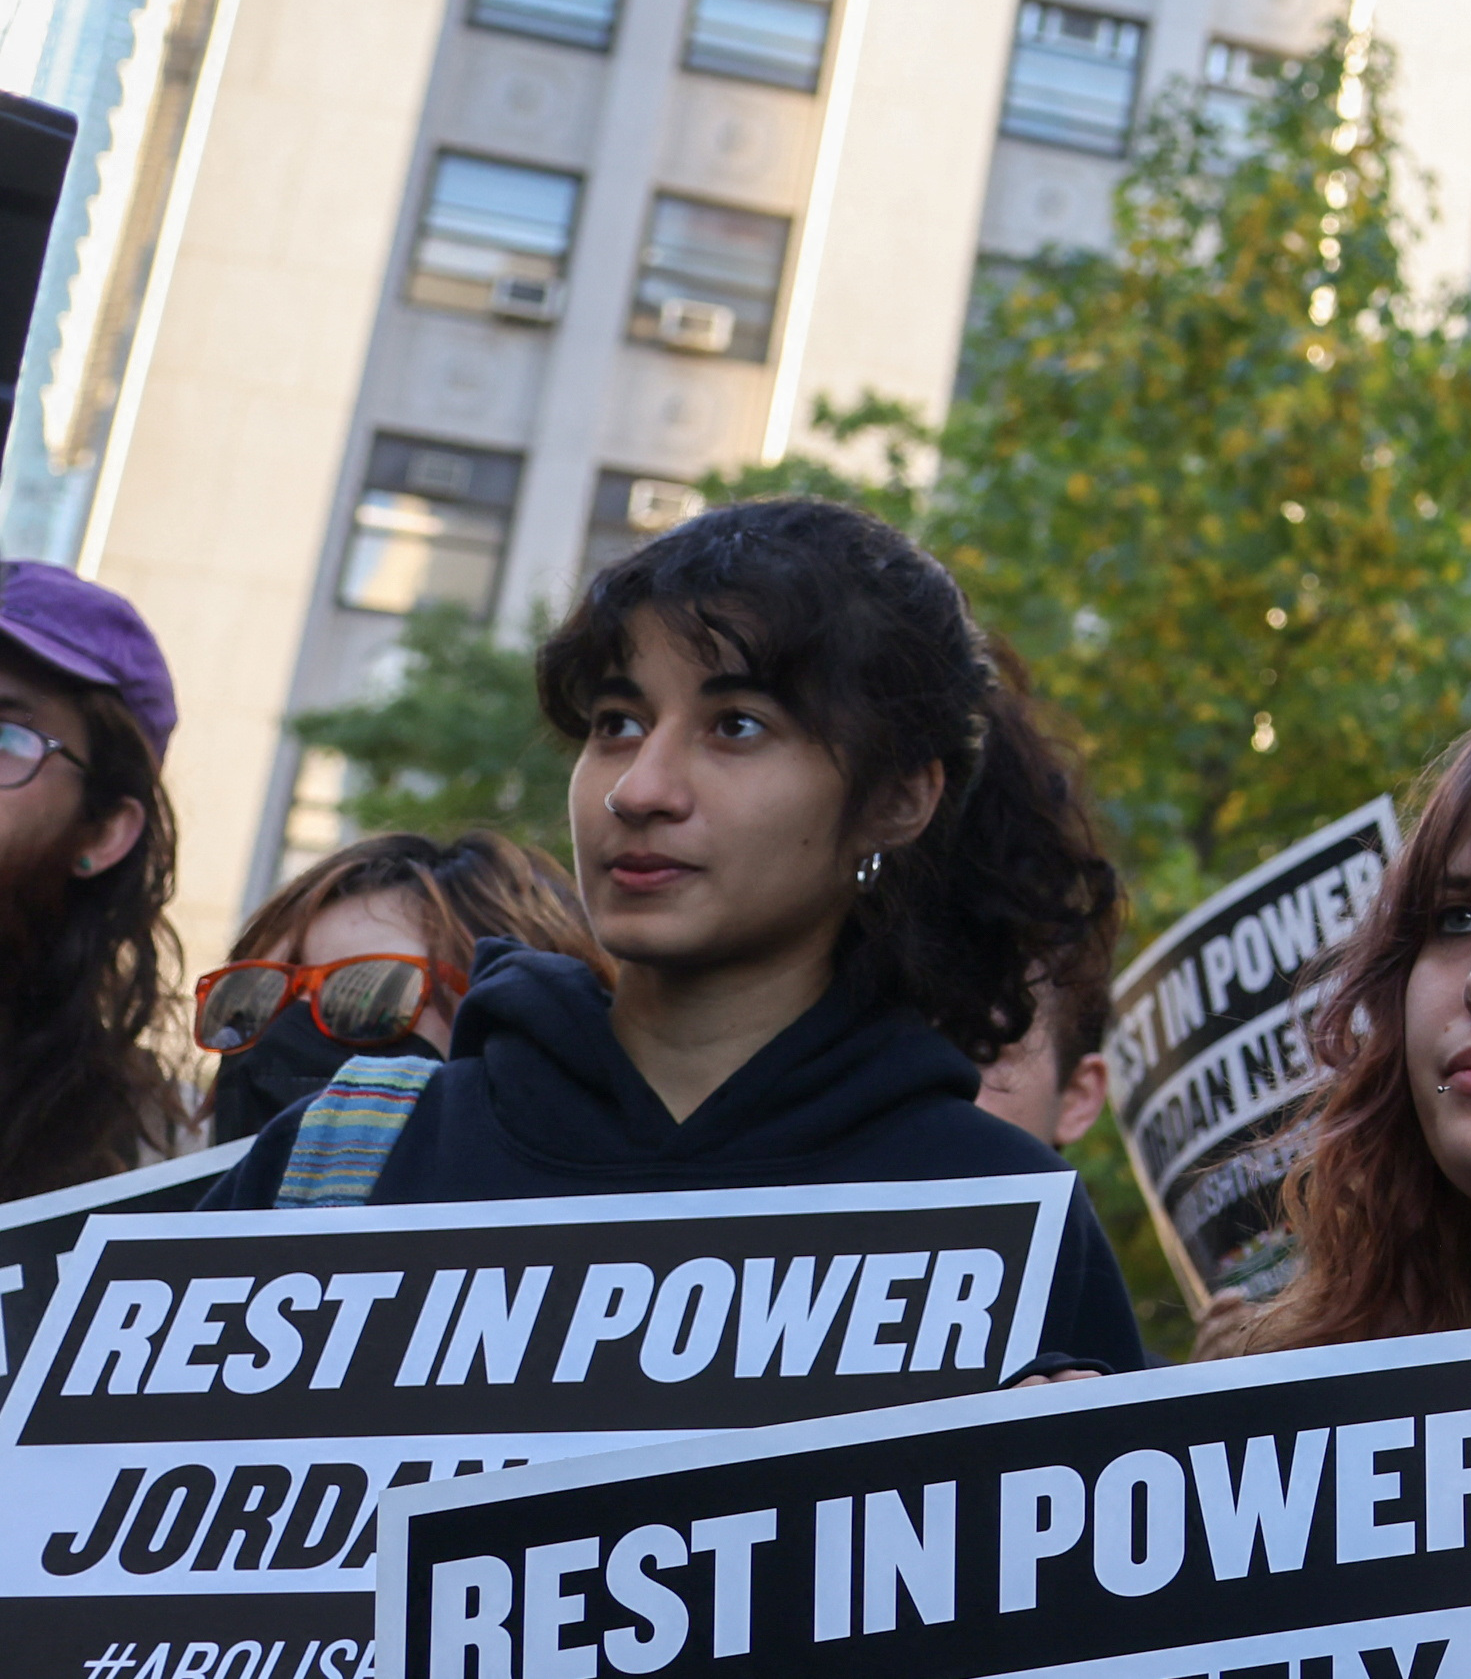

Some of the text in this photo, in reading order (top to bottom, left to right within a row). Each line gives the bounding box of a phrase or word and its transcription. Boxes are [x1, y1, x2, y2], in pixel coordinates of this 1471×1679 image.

[1157, 955, 1206, 1051] IN
[61, 1270, 404, 1395] REST
[394, 1266, 553, 1387] IN
[552, 1249, 1004, 1384] POWER
[42, 1458, 527, 1576] JORD
[430, 1507, 777, 1679] REST
[814, 1480, 957, 1643] IN
